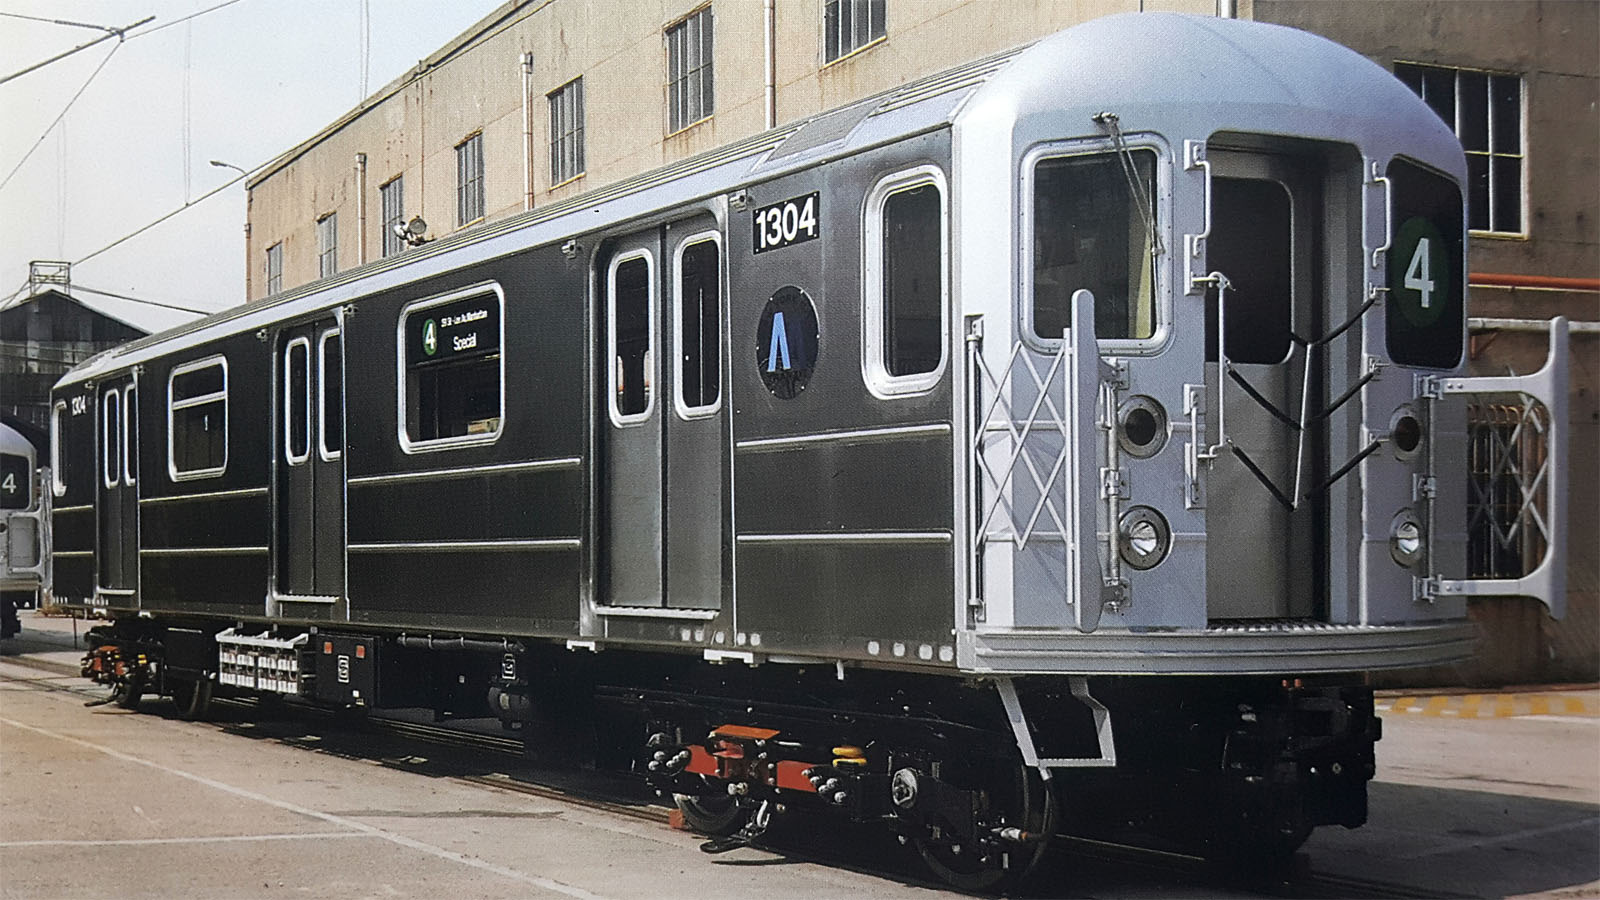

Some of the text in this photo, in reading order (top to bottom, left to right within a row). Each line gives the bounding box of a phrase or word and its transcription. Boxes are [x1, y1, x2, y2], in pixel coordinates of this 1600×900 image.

[756, 197, 816, 249] 1304
[1404, 238, 1434, 308] 4
[425, 323, 436, 349] 4
[2, 473, 17, 494] 4
